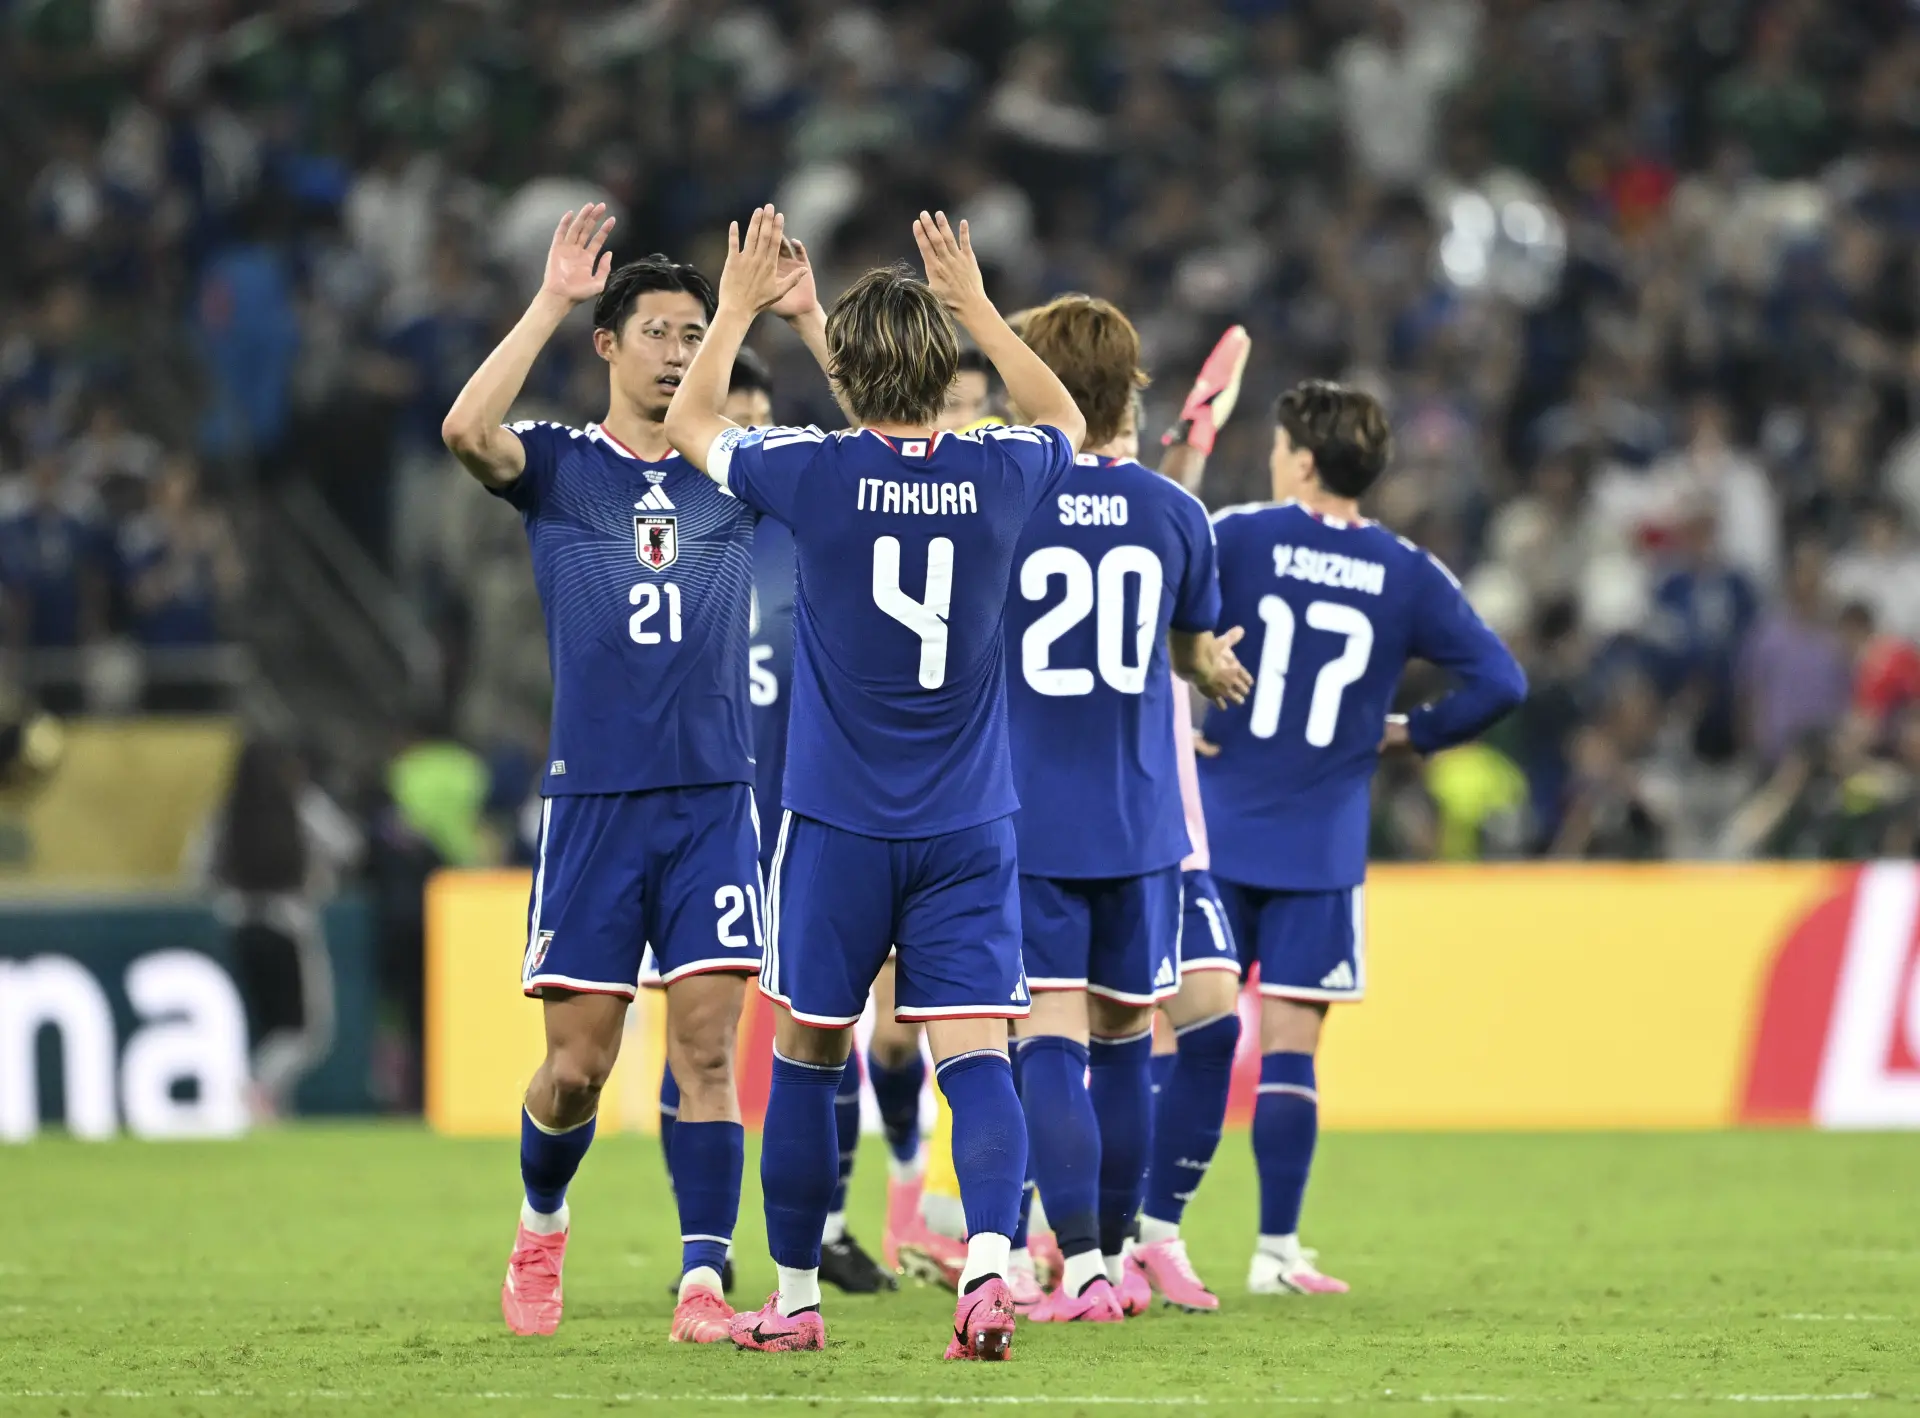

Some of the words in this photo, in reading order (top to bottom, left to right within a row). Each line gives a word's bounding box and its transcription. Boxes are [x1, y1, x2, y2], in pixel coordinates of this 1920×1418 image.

[857, 477, 978, 515] ITAKURA
[1057, 493, 1129, 526] SEKO
[648, 553, 666, 561] JFA
[628, 582, 682, 645] 21
[872, 535, 955, 690] 4
[1019, 545, 1163, 697] 20
[1250, 594, 1374, 748] 17
[714, 884, 763, 948] 21
[1195, 897, 1237, 954] 1
[1812, 858, 1920, 1129] L
